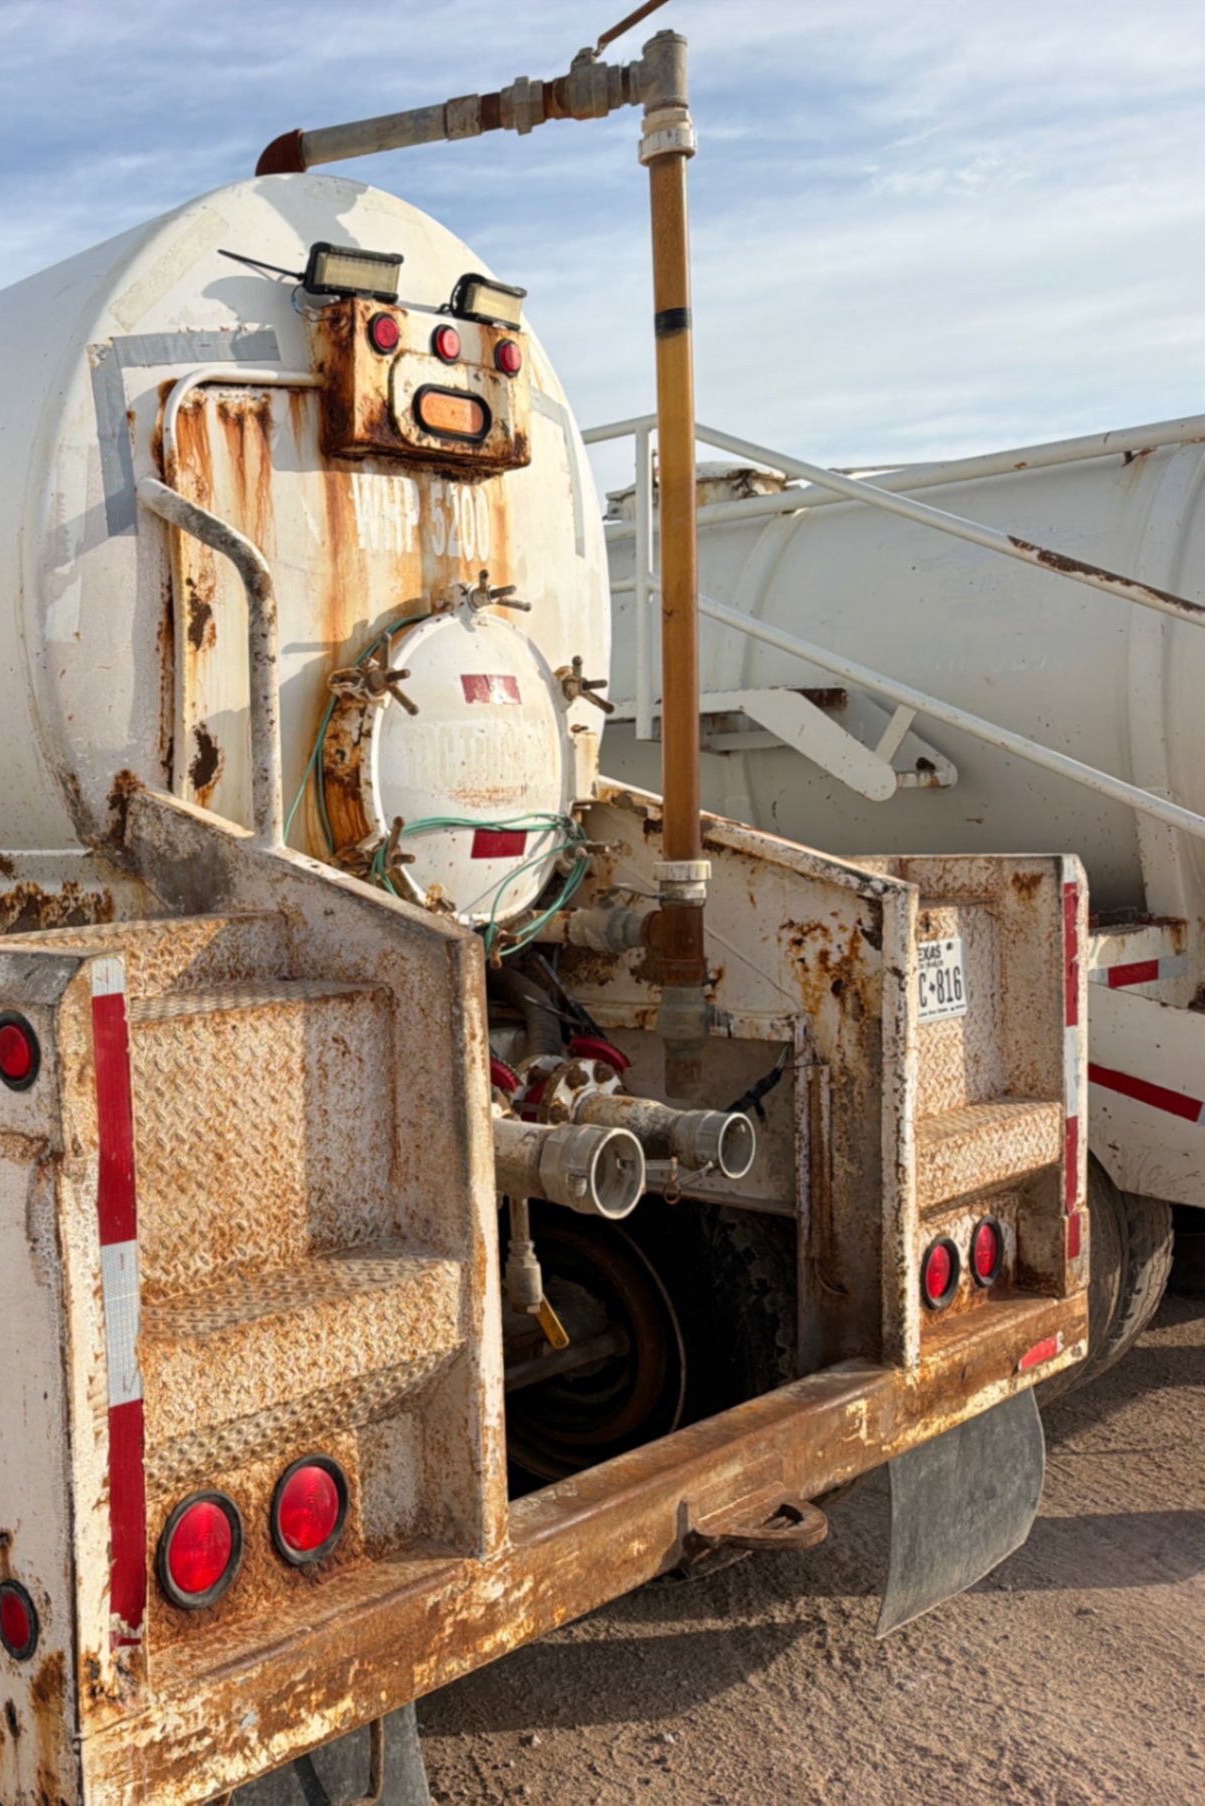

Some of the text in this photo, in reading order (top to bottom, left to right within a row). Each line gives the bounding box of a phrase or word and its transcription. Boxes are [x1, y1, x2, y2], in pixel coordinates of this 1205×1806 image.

[351, 472, 490, 561] WHP 5200
[918, 944, 941, 962] EXAS
